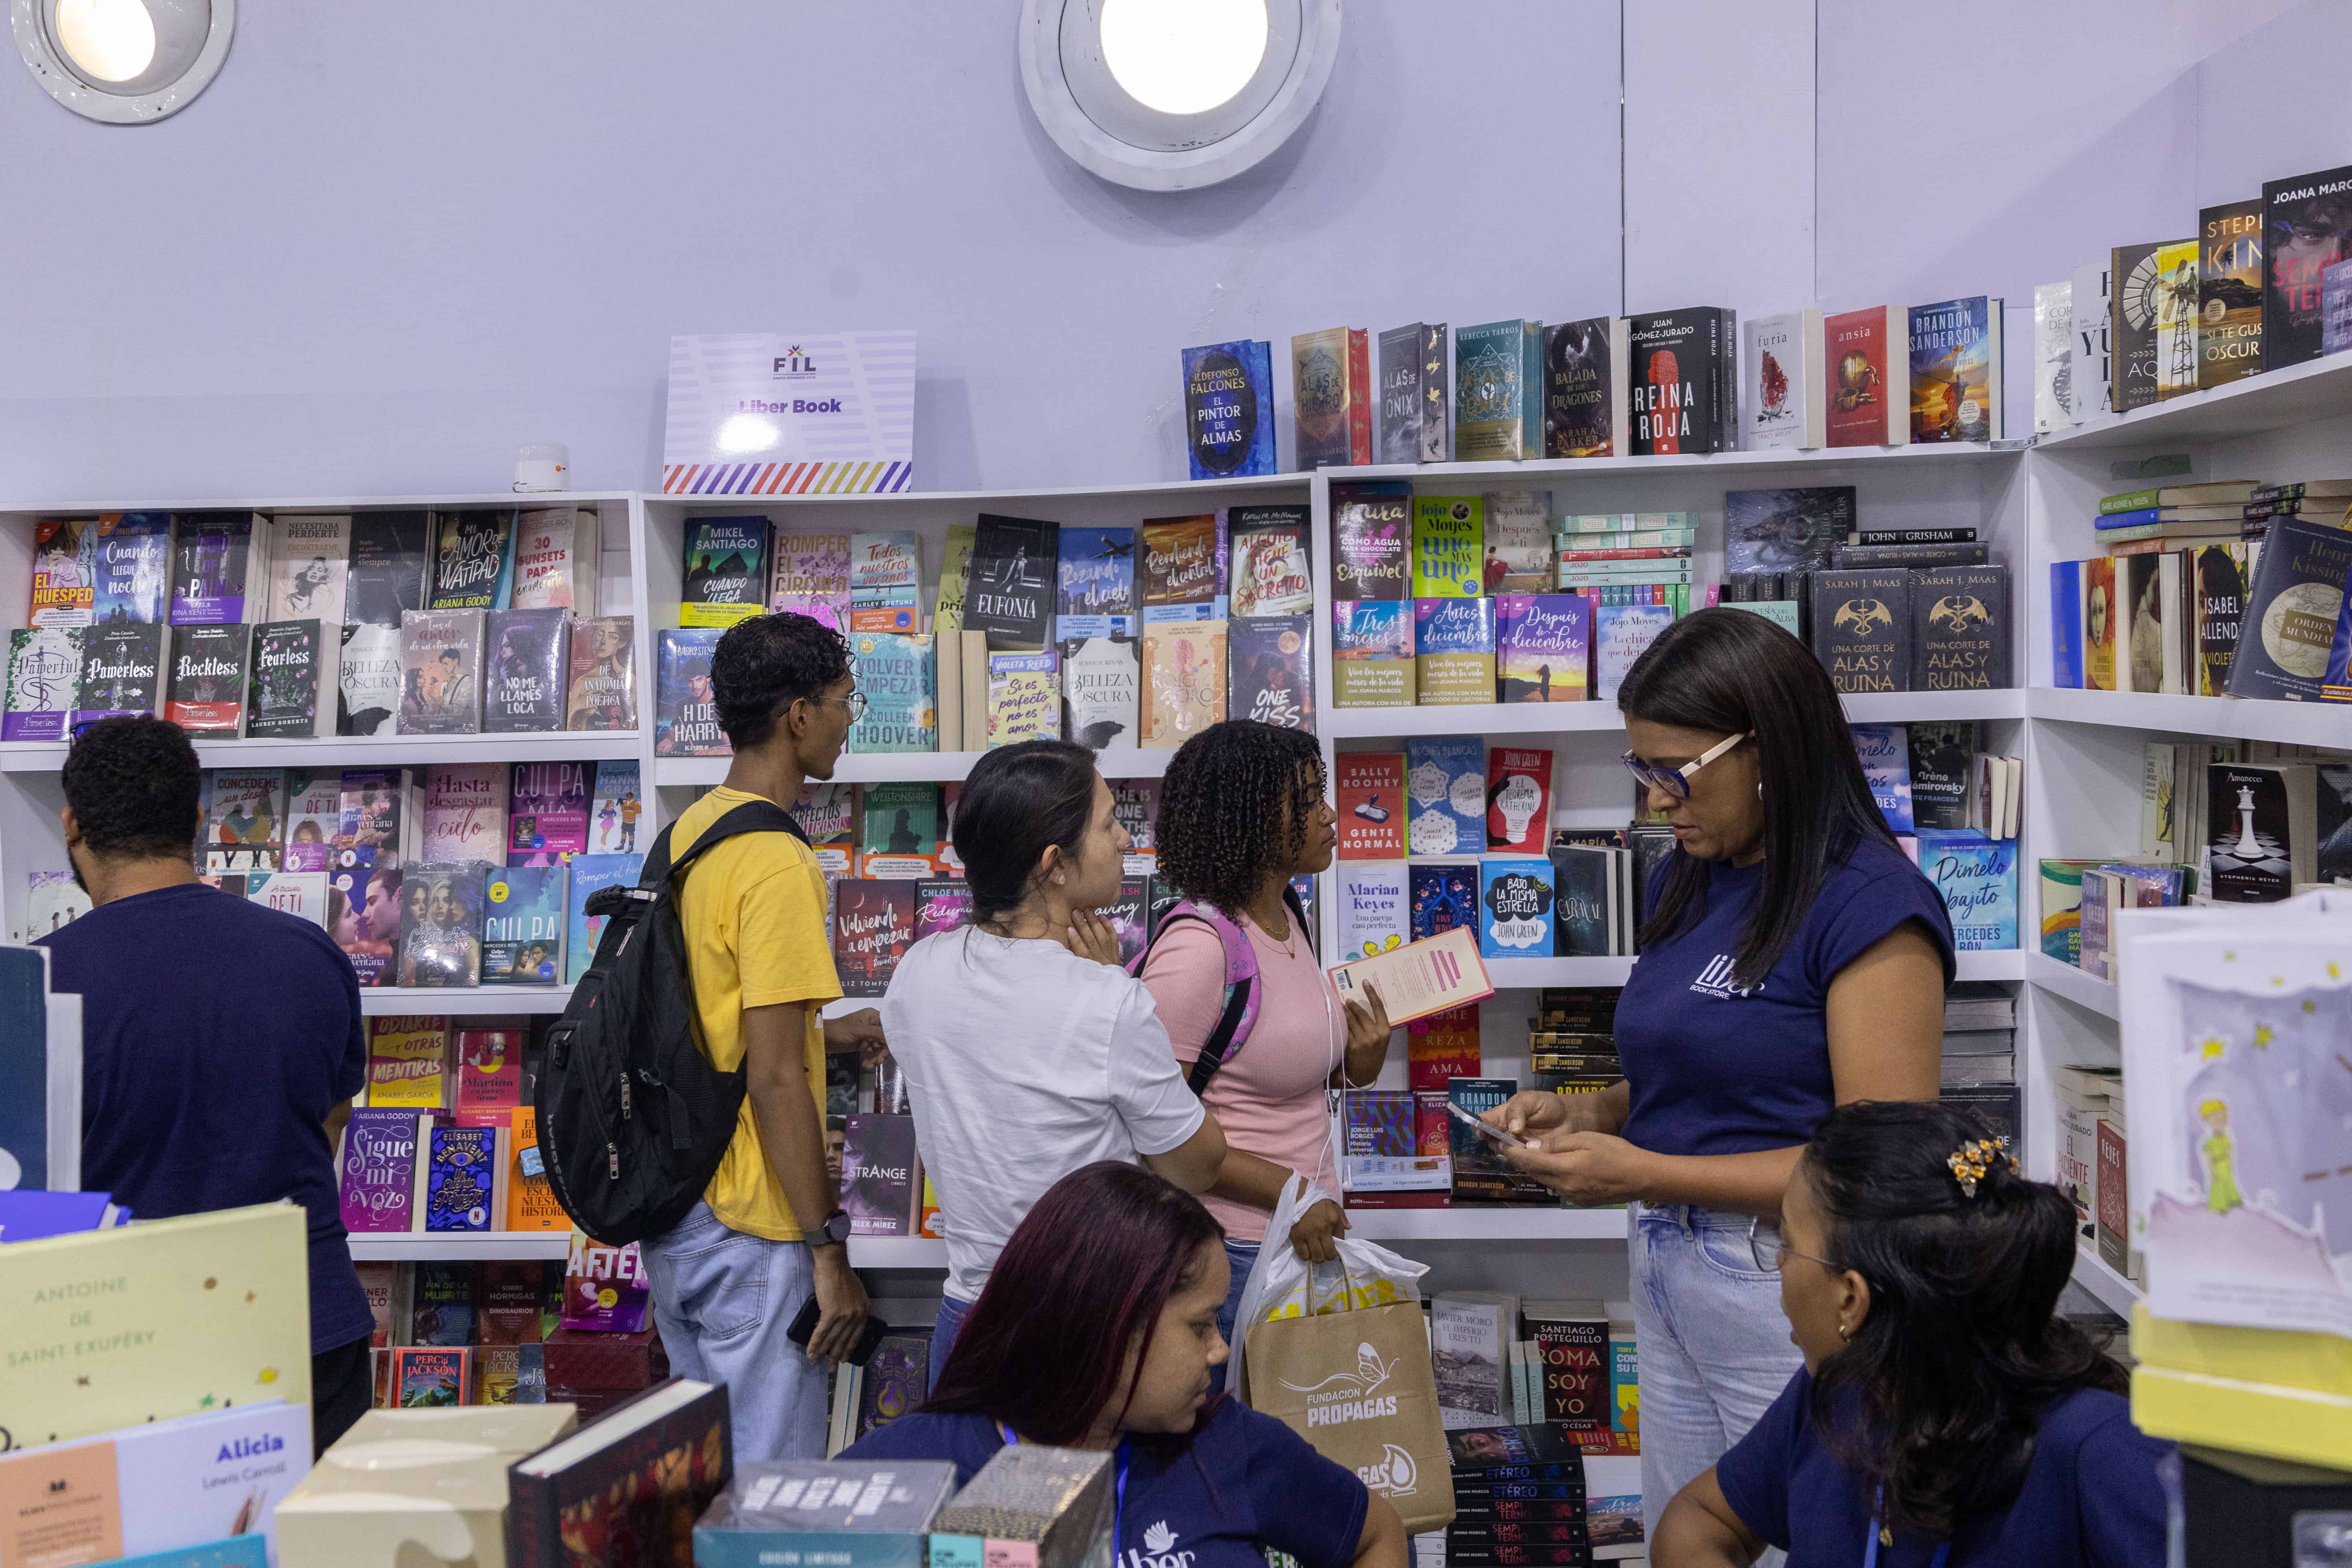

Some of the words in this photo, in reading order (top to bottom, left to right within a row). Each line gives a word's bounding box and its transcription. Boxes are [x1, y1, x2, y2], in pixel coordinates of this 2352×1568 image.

[1652, 318, 1672, 328] JUAN
[1916, 310, 1972, 333] BRANDON
[1459, 329, 1490, 341] REBECCA
[1492, 325, 1520, 337] YARROS
[1631, 326, 1694, 341] GÓMEZ-JURADO
[1757, 330, 1789, 350] furia
[1838, 325, 1871, 341] ansia
[1910, 327, 1980, 352] SANDERSON
[773, 357, 816, 372] FIL
[1194, 367, 1239, 382] ILDEFONSO
[1383, 368, 1408, 386] ALAS
[1408, 375, 1416, 385] DE
[1555, 368, 1596, 384] BALADA
[1190, 376, 1245, 395] FALCONES
[1213, 397, 1224, 407] EL
[1552, 390, 1602, 407] DRAGONES
[1634, 382, 1694, 412] REINA
[739, 400, 788, 414] Liber
[793, 399, 842, 413] Book
[1198, 405, 1241, 421] PINTOR
[1386, 392, 1414, 419] ÓNIX
[1215, 420, 1225, 430] DE
[1639, 411, 1690, 440] ROJA
[1201, 430, 1242, 446] ALMAS
[289, 522, 339, 531] NECESITABA
[465, 524, 477, 534] MI
[711, 527, 744, 539] MIKEL
[1426, 518, 1472, 533] Moyes
[288, 529, 339, 539] PERDERTE
[1239, 523, 1302, 552] ALGUIEN
[1869, 532, 1896, 543] JOHN
[1906, 531, 1953, 540] GRISHAM
[534, 536, 551, 551] 30
[695, 538, 758, 551] SANTIAGO
[778, 534, 849, 554] ROMPER
[517, 549, 566, 567] SUNSETS
[867, 543, 902, 562] Todos
[777, 555, 795, 575] EL
[1259, 565, 1278, 580] UN
[1336, 561, 1404, 583] Esquivel
[35, 573, 49, 588] EL
[189, 578, 226, 598] PAIN
[703, 577, 748, 594] CUANDO
[33, 587, 93, 604] HUÉSPED
[432, 597, 464, 609] ARIANA
[466, 595, 492, 608] GODOY
[853, 600, 879, 609] CARLEY
[881, 598, 913, 606] FORTUNE
[978, 594, 1036, 619] EUFONÍA
[2204, 596, 2239, 614] ISABEL
[1434, 601, 1479, 625] Antes
[1526, 605, 1580, 627] Después
[1609, 616, 1629, 628] Jojo
[1631, 616, 1659, 628] Moyes
[2294, 617, 2333, 633] ORDEN
[1832, 643, 1852, 654] UNA
[1853, 643, 1879, 653] CORTE
[1881, 643, 1895, 652] DE
[1927, 641, 1946, 651] UNA
[1947, 641, 1974, 650] CORTE
[1976, 640, 1991, 649] DE
[86, 656, 154, 684] Powerless
[175, 654, 238, 681] Reckless
[995, 659, 1025, 671] VIOLETA
[1027, 658, 1051, 670] REED
[506, 676, 519, 689] NO
[521, 676, 538, 689] ME
[500, 689, 542, 703] LLAMES
[997, 693, 1050, 713] perfecto
[1255, 688, 1291, 706] ONE
[507, 702, 535, 715] LOCA
[279, 717, 309, 726] ROBERTS
[870, 711, 916, 723] COLLEEN
[857, 725, 929, 746] HOOVER
[1351, 768, 1390, 777] SALLY
[1918, 771, 1949, 781] Irène
[2226, 772, 2263, 783] Amanecer
[217, 777, 279, 790] CONCÉDEME
[434, 775, 490, 794] Hasta
[514, 764, 585, 797] CULPA
[1343, 778, 1399, 788] ROONEY
[1350, 828, 1394, 838] GENTE
[1343, 838, 1402, 849] NORMAL
[1935, 851, 2008, 884] Dímelo
[1348, 883, 1400, 896] Marian
[1507, 877, 1528, 890] BAJO
[922, 889, 951, 898] CHLOE
[1353, 896, 1395, 910] Keyes
[1496, 901, 1539, 913] ESTRELLA
[839, 903, 898, 937] Volviendo
[1367, 921, 1396, 931] perfecta
[1690, 984, 1707, 993] BOOK
[1708, 989, 1730, 1000] STORE
[1427, 1035, 1466, 1046] REZA
[372, 1060, 442, 1081] MENTIRAS
[1430, 1063, 1464, 1074] AMA
[376, 1091, 405, 1099] ANABEL
[407, 1090, 435, 1099] GARCÍA
[1460, 1093, 1507, 1105] BRANDON
[386, 1112, 415, 1120] GODOY
[443, 1131, 483, 1142] ELÍSABET
[1996, 1136, 2010, 1146] DE
[2066, 1135, 2075, 1155] EL
[2101, 1138, 2121, 1168] REDES
[872, 1219, 896, 1229] MÍREZ
[33, 1275, 127, 1305] ANTOINE
[424, 1291, 468, 1300] MUERTE
[70, 1311, 93, 1327] DE
[1436, 1311, 1464, 1324] JAVIER
[1466, 1315, 1493, 1327] MORO
[1540, 1324, 1595, 1335] SANTIAGO
[1533, 1333, 1602, 1344] POSTEGUILLO
[415, 1355, 450, 1365] PERCY
[406, 1364, 457, 1379] JACKSON
[1616, 1363, 1629, 1373] SU
[1548, 1373, 1589, 1391] SOY
[1307, 1388, 1361, 1405] FUNDACION
[1307, 1395, 1398, 1428] PROPAGAS
[1557, 1398, 1585, 1414] YO
[215, 1432, 284, 1463] Alicia
[202, 1473, 240, 1490] Lewis
[241, 1461, 287, 1484] Carroll
[1486, 1465, 1530, 1480] ETÉREO
[1493, 1484, 1537, 1498] ETÉREO
